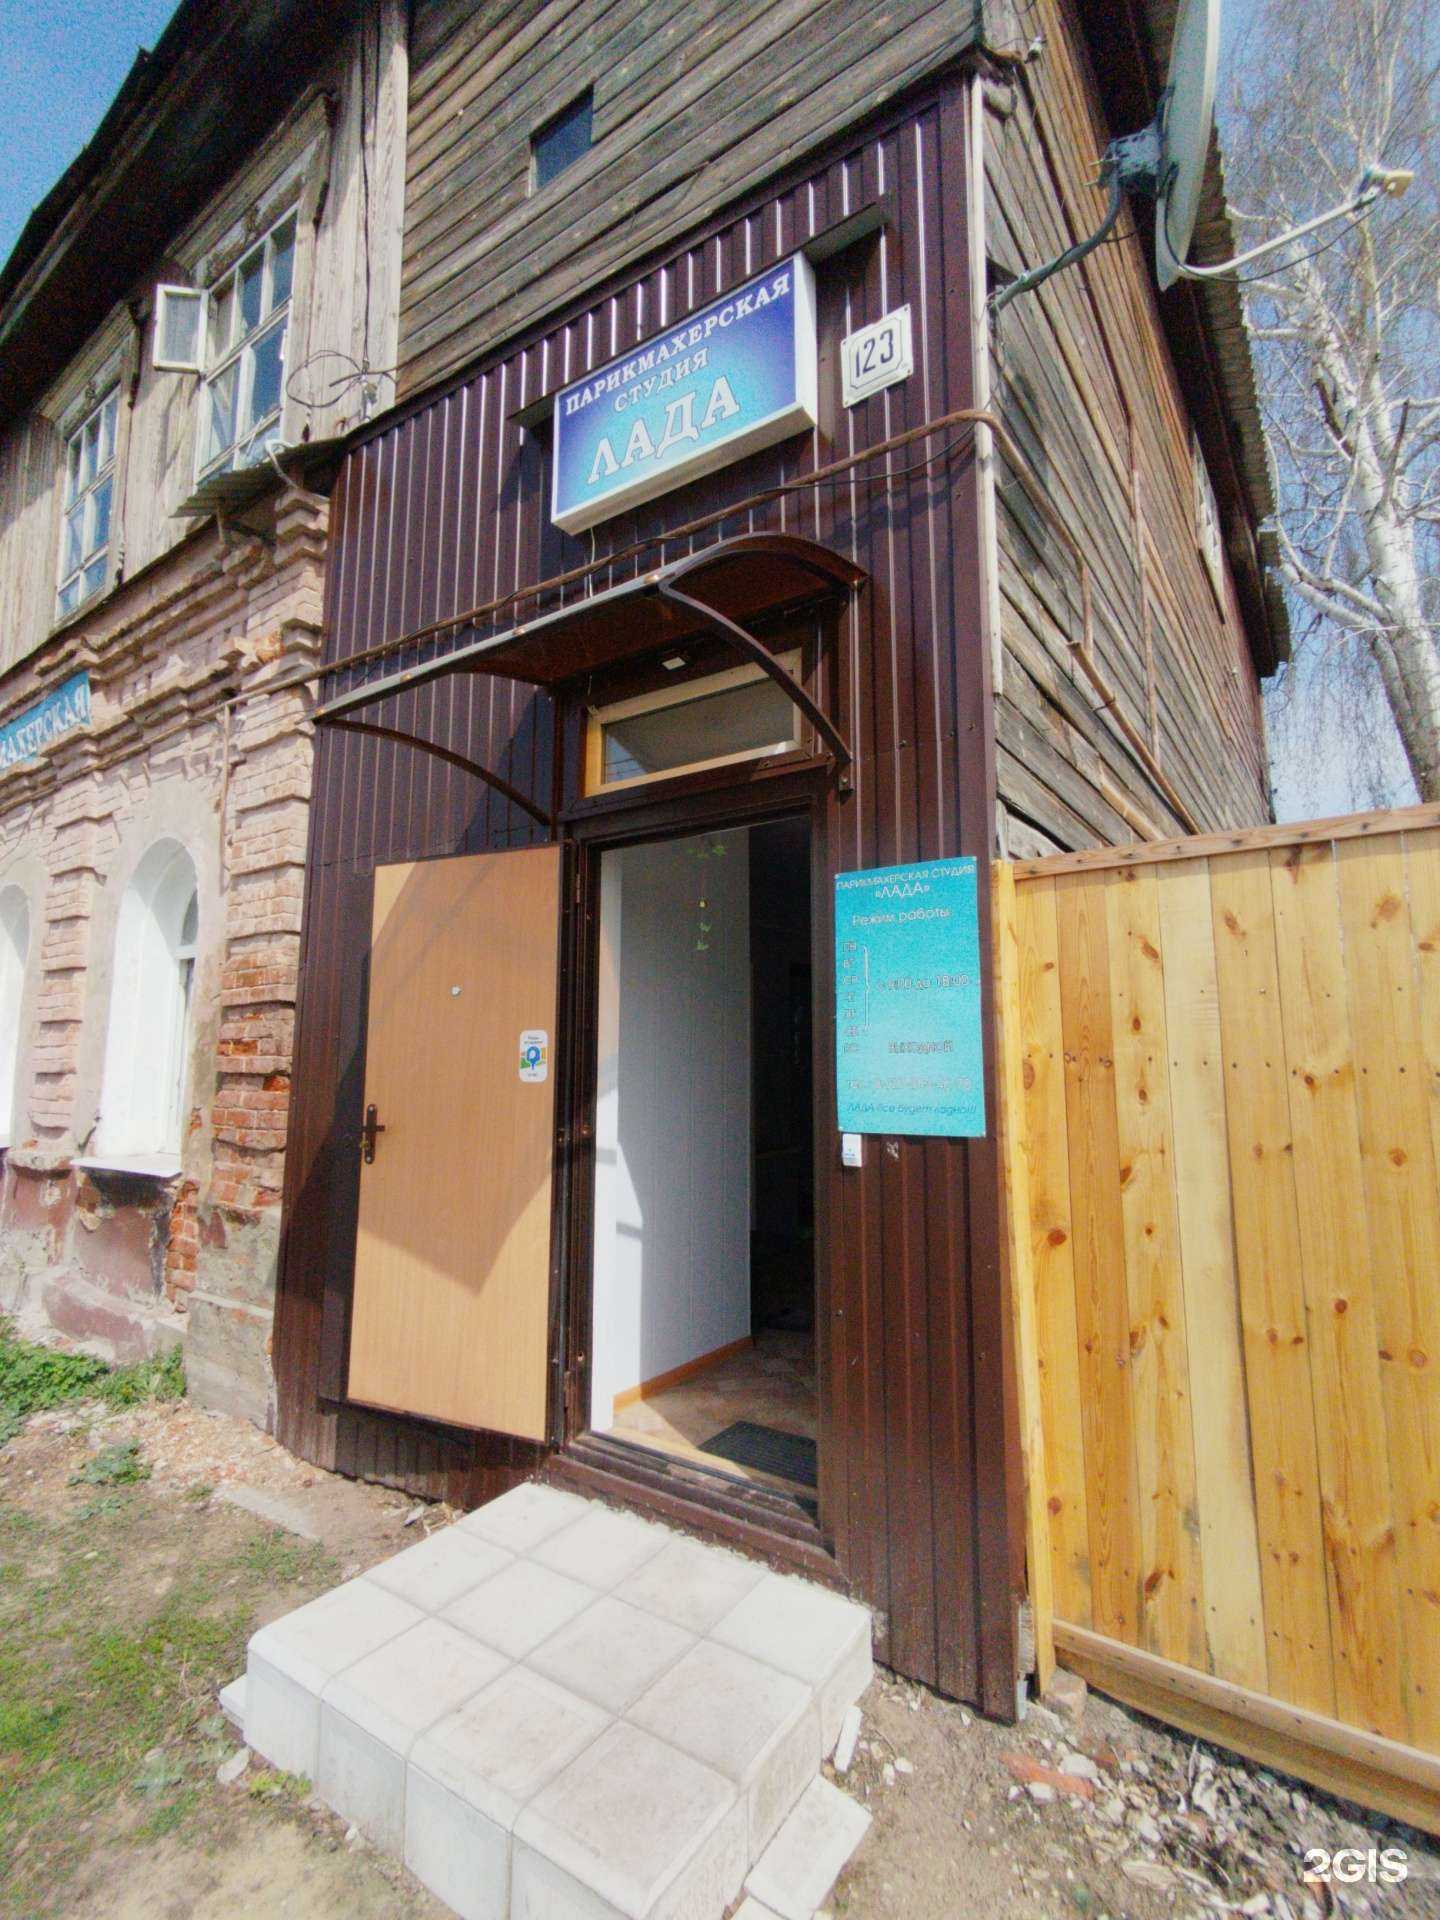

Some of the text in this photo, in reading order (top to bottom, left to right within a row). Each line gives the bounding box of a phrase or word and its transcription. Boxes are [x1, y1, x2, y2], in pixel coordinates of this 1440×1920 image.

[565, 273, 790, 416] ПАРИКМАХЕРСКАЯ
[855, 328, 894, 378] 123
[613, 347, 710, 413] СТУДИЯ
[586, 375, 741, 485] ЛАДА
[931, 864, 976, 879] СТУДИЯ
[898, 907, 951, 924] работы
